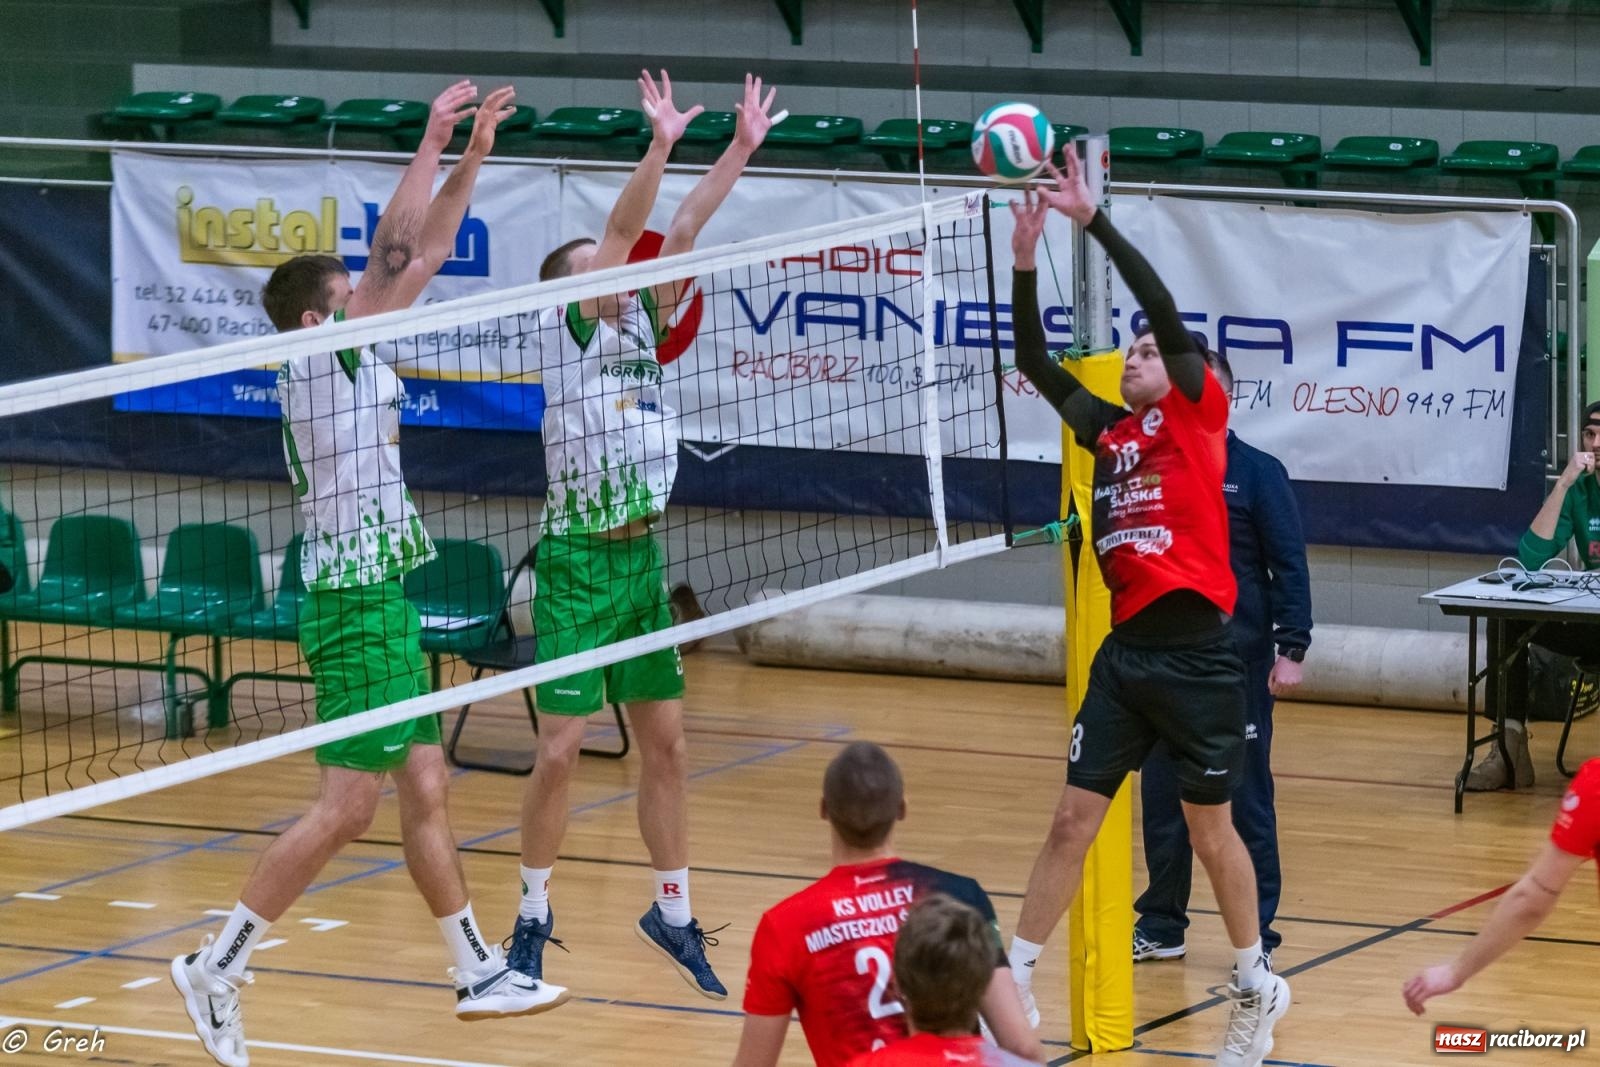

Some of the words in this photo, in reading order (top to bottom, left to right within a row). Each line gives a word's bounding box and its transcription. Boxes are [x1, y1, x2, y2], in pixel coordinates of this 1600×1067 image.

[192, 287, 228, 305] 414
[148, 314, 212, 335] 47-400
[1336, 321, 1505, 372] FM
[1231, 379, 1272, 409] FM
[1293, 383, 1400, 417] OLESNO
[1406, 393, 1454, 420] 94,9
[1462, 388, 1505, 419] FM
[662, 883, 681, 896] R
[832, 897, 857, 917] KS
[856, 885, 913, 913] VOLLEY
[217, 919, 255, 971] SKECHERS
[460, 916, 490, 963] SKECHERS
[804, 914, 898, 954] MIASTECZKO
